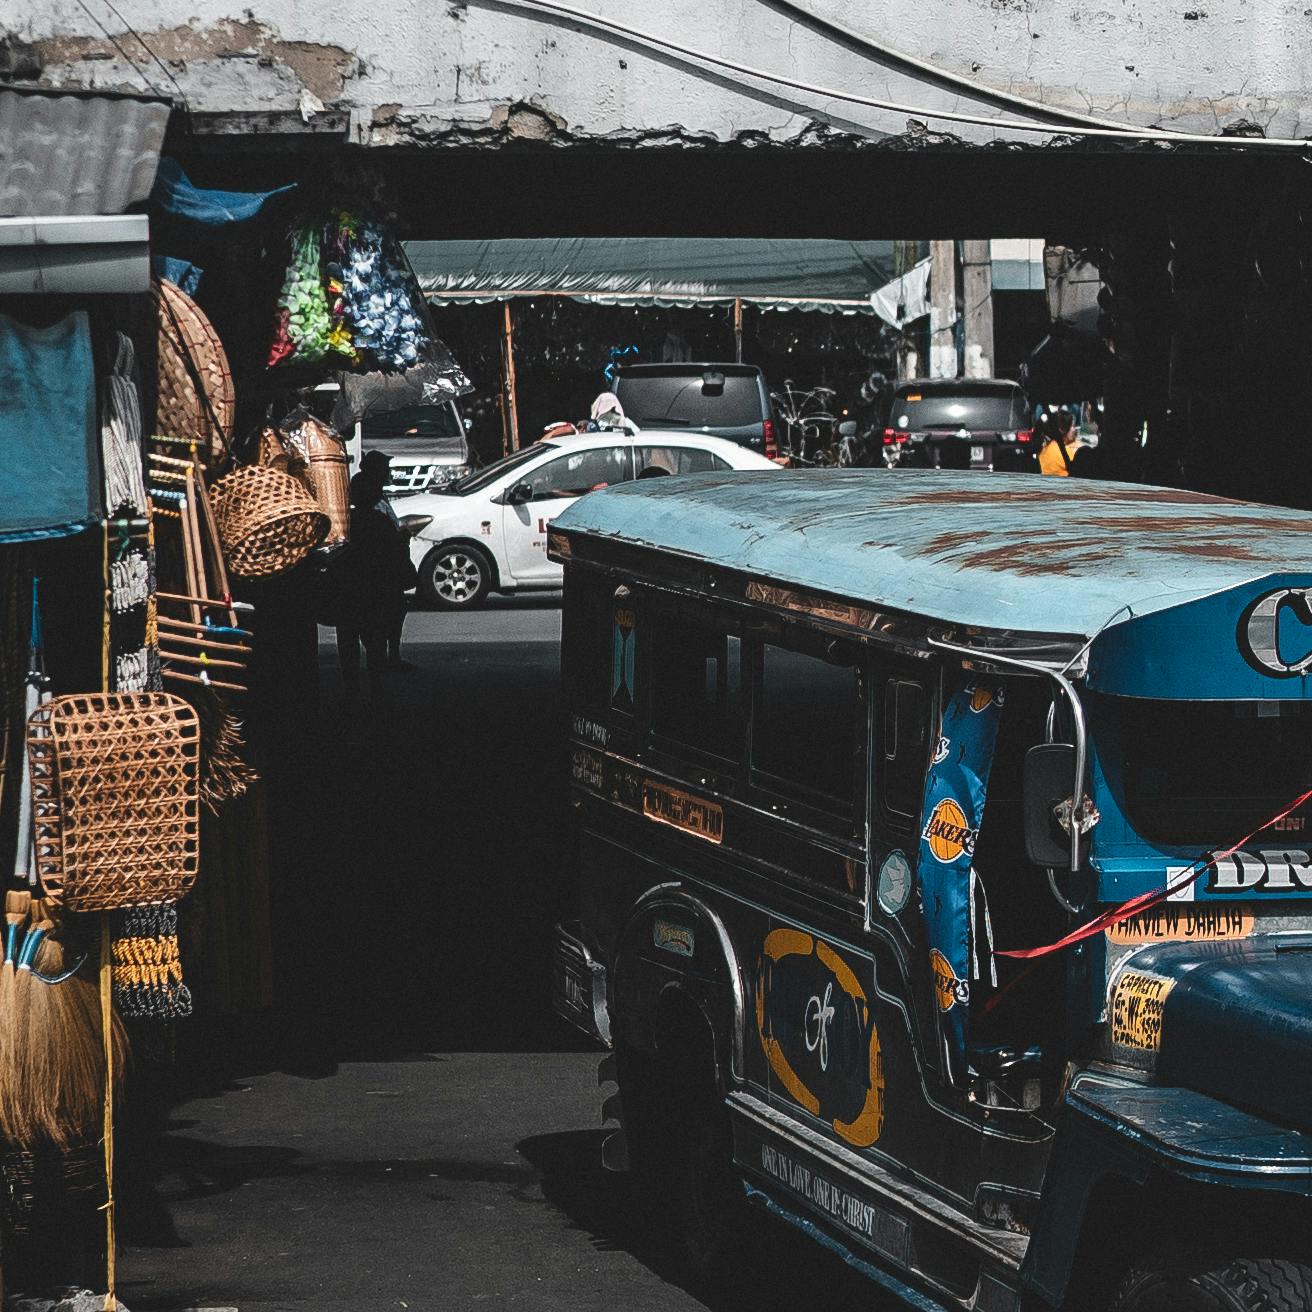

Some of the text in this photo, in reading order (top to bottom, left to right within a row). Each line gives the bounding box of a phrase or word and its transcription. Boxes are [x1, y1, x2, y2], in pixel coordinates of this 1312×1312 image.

[1119, 974, 1165, 999] CAPACITY
[813, 1176, 831, 1211] ONE
[842, 1192, 876, 1237] CHRIST
